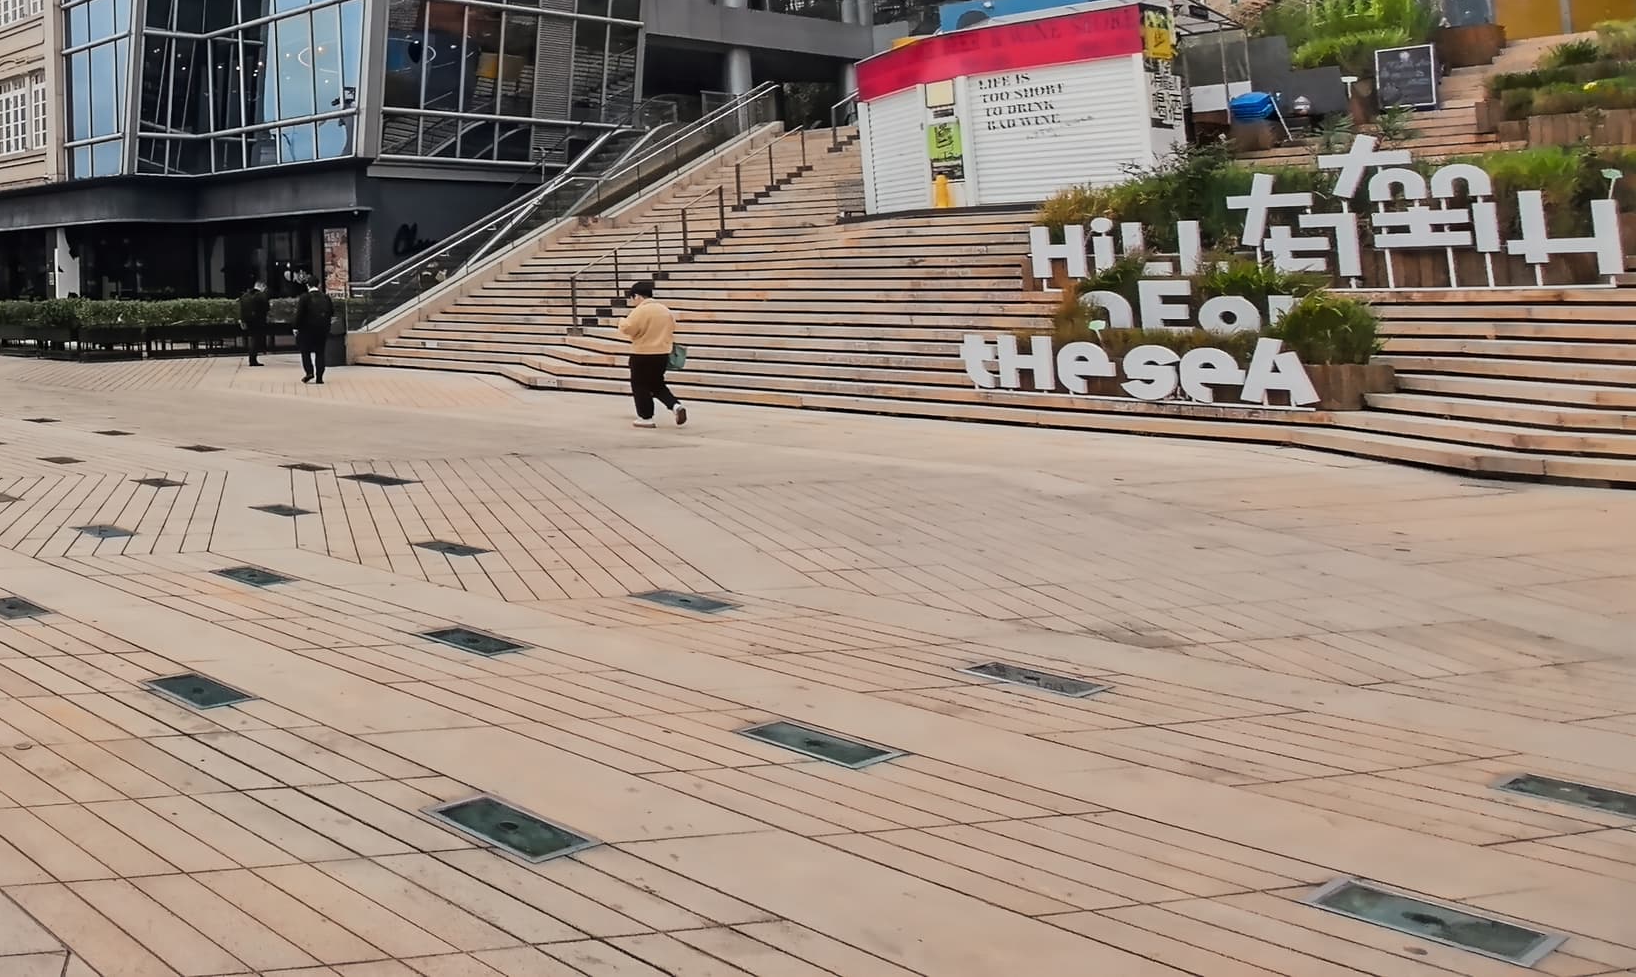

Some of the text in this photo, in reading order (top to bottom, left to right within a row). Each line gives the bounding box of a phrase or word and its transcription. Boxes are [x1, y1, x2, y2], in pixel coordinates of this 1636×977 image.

[978, 72, 1031, 90] LIFE IS
[980, 83, 1065, 104] TOO SHORT
[985, 100, 1055, 117] TO DRINK
[987, 119, 1016, 131] BAD
[1019, 114, 1061, 127] WINE
